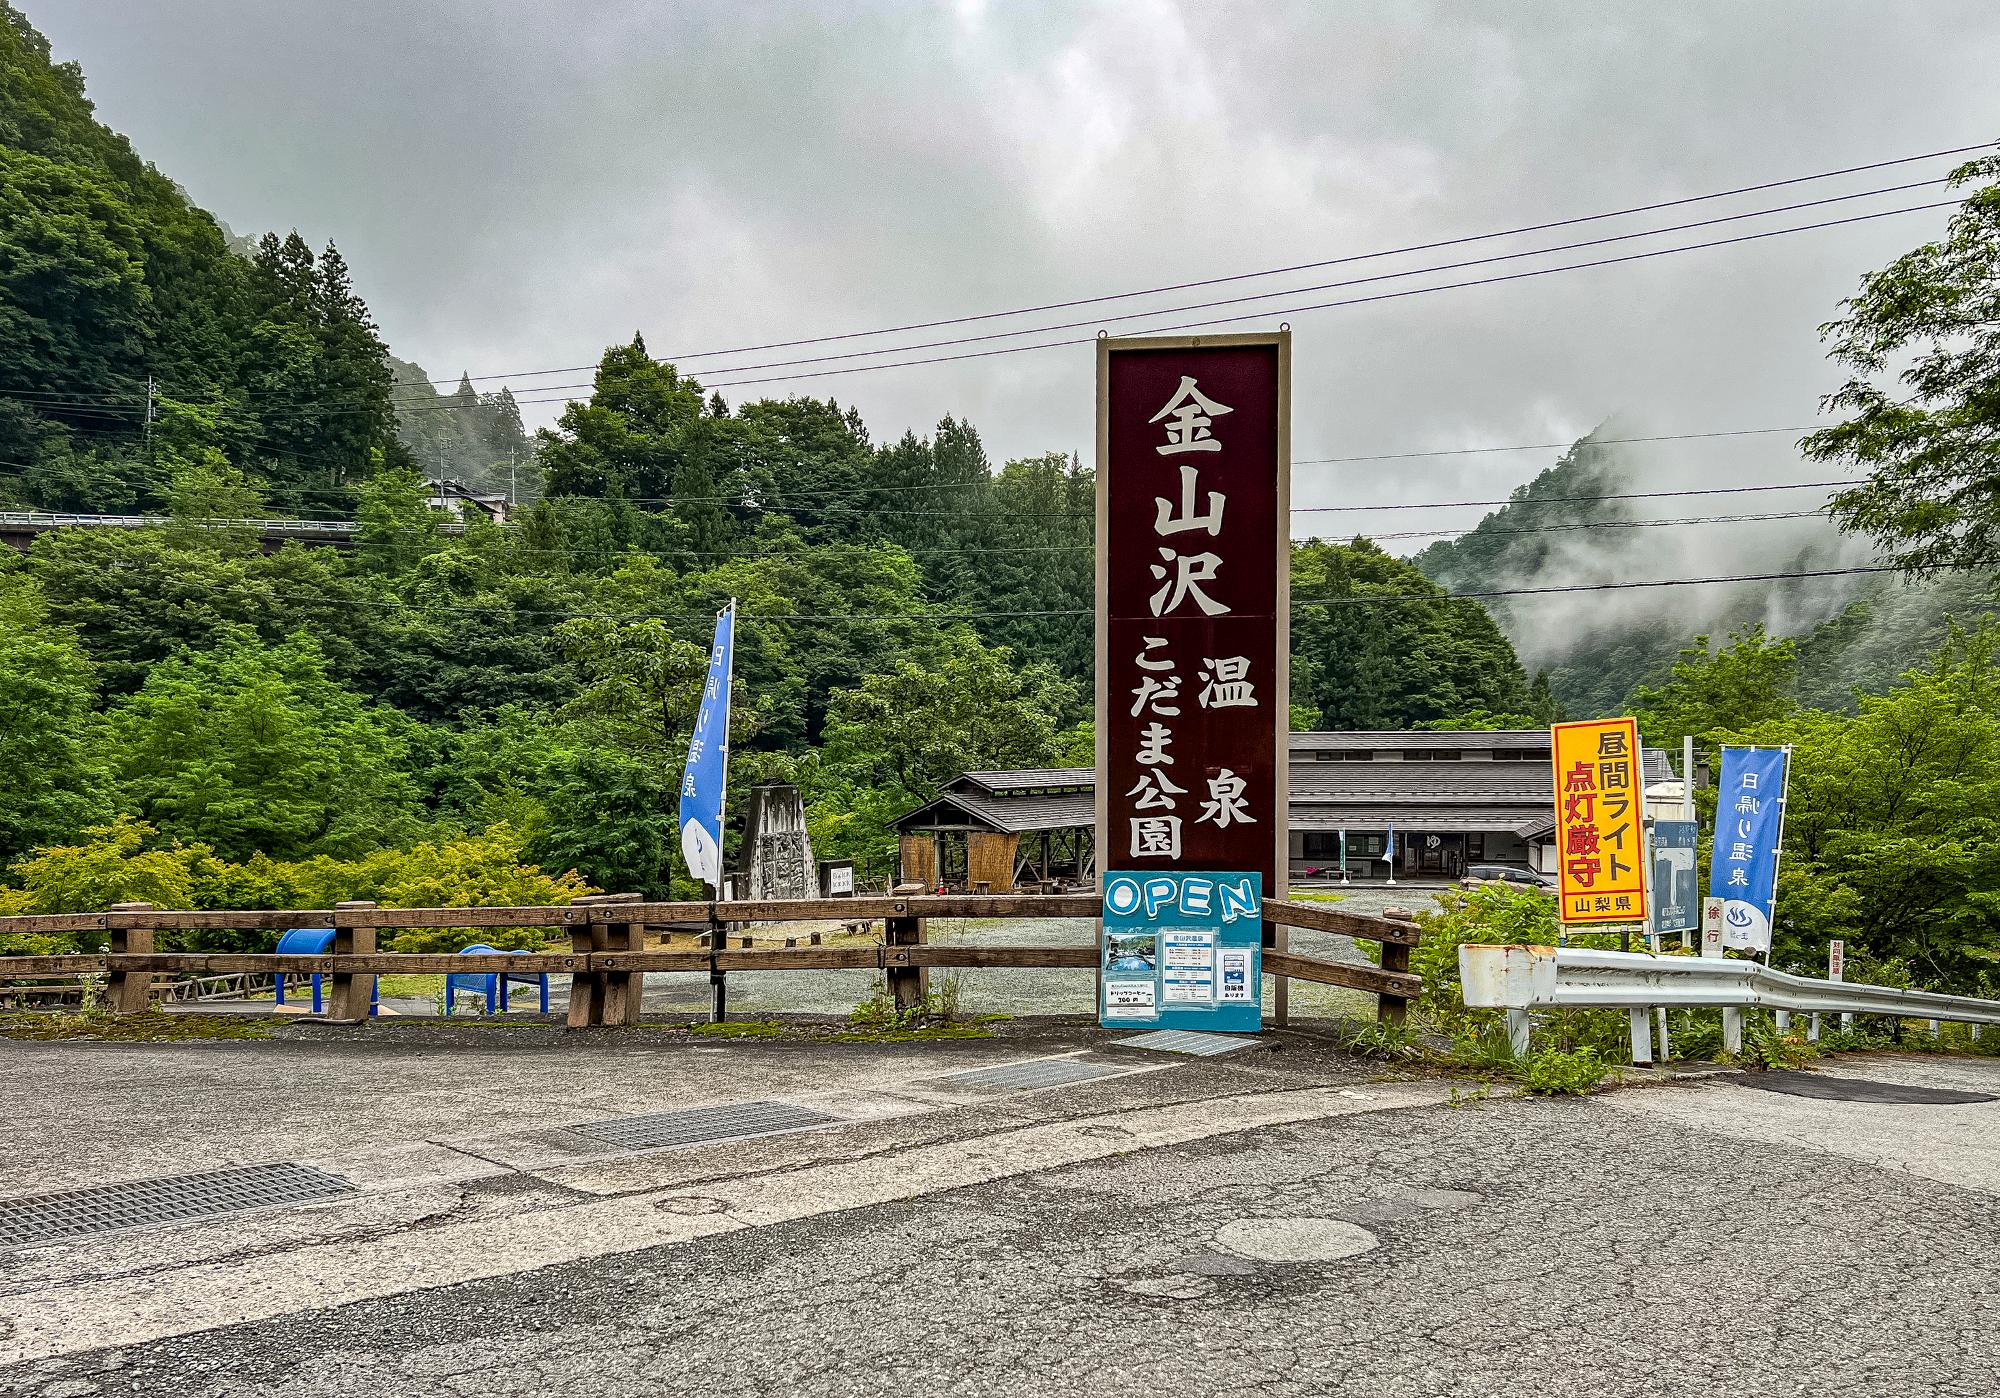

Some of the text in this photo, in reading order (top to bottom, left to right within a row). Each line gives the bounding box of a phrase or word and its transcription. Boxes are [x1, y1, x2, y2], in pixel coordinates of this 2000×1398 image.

[1149, 375, 1234, 617] 金山沢
[1125, 635, 1188, 860] こだま公園
[1194, 655, 1259, 829] 温泉
[1597, 730, 1632, 881] 昼間ライト
[1564, 760, 1602, 888] 点灯厳守
[1105, 877, 1259, 923] OPEN
[1575, 896, 1632, 913] 山梨県
[1707, 905, 1720, 943] 徐行
